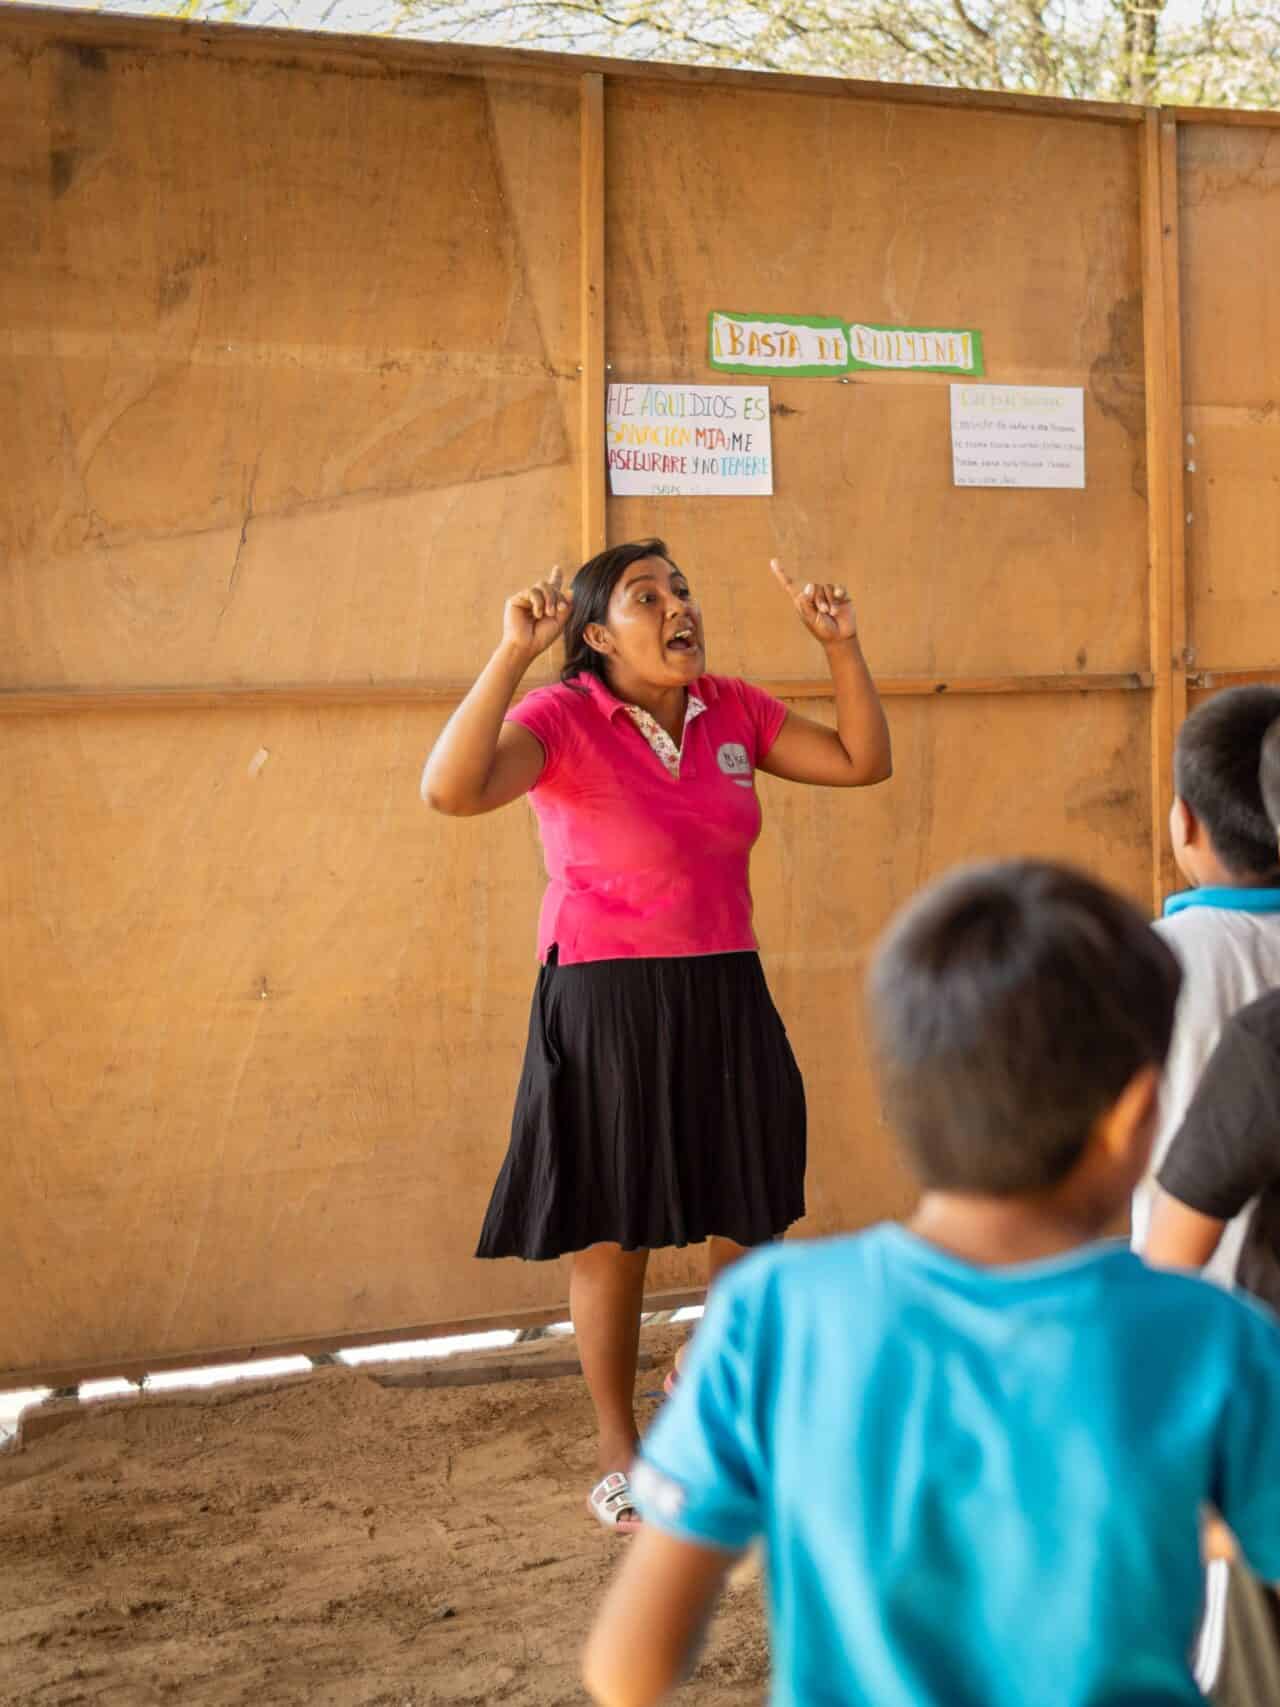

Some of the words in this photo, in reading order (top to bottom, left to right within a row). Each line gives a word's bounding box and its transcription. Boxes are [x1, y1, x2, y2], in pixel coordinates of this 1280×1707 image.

[607, 385, 634, 416] HE
[640, 388, 686, 418] AQUI
[689, 391, 737, 420] DIOS
[743, 396, 768, 421] ES
